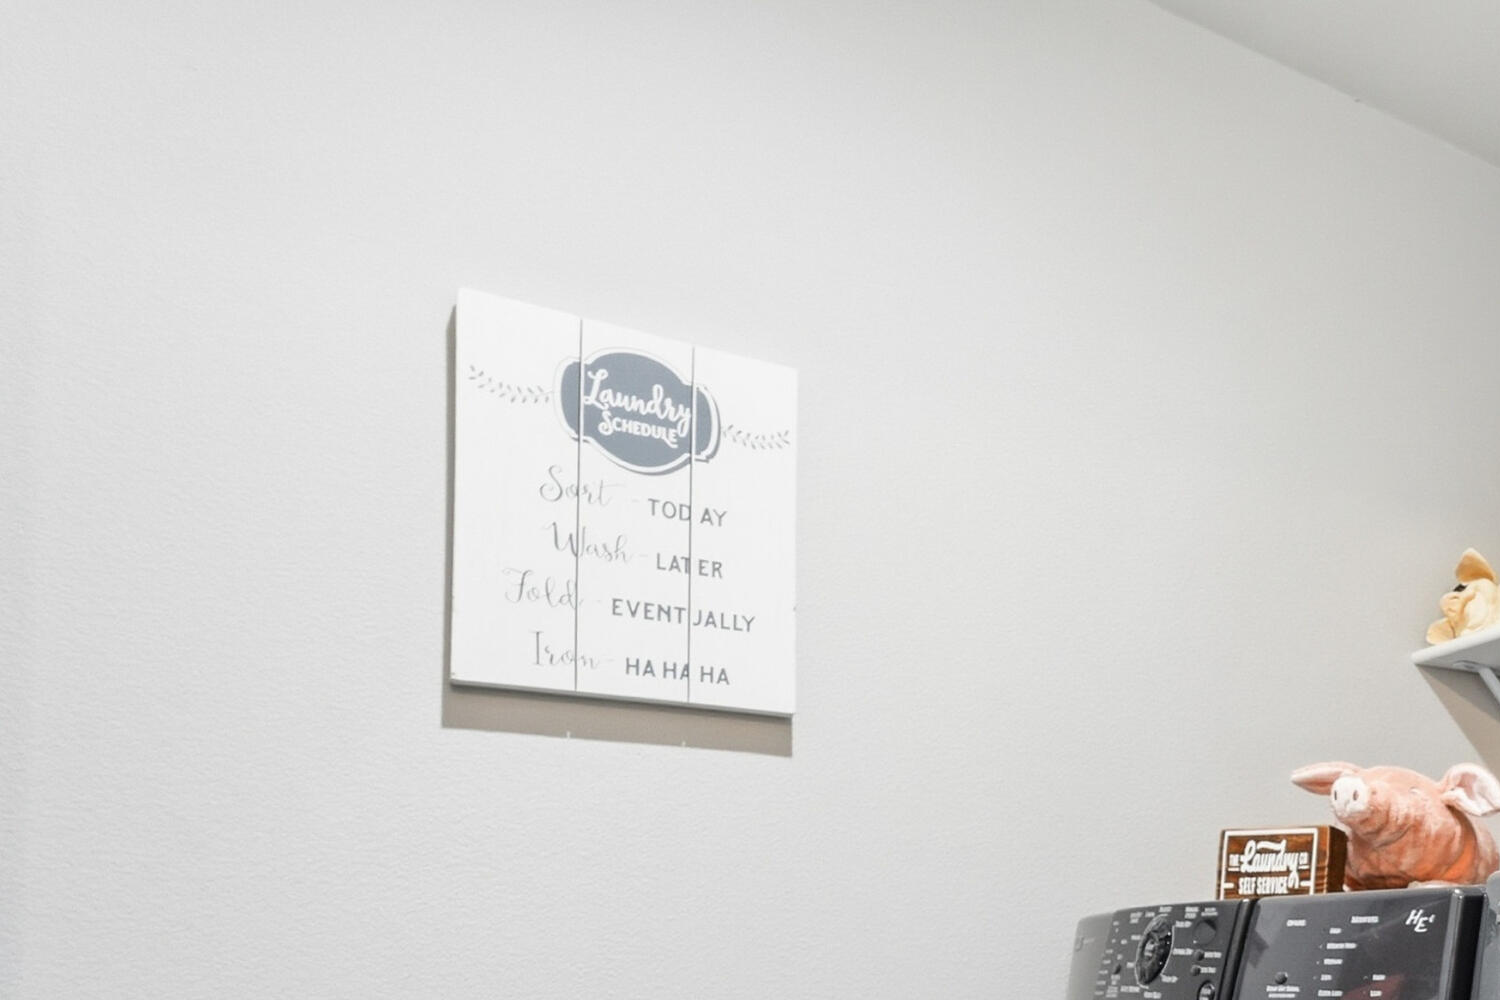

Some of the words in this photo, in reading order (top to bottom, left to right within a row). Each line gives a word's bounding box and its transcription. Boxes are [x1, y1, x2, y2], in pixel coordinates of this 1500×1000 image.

[583, 368, 691, 437] Laundry
[539, 465, 622, 506] Sort
[648, 498, 728, 527] TODAY
[542, 522, 632, 564] Wash
[656, 553, 723, 578] LATER
[502, 568, 584, 608] Fold
[530, 630, 600, 670] Iron
[625, 657, 656, 677] HA
[663, 661, 689, 681] HA
[699, 666, 730, 686] HA
[1238, 877, 1256, 895] SELF
[1240, 839, 1299, 889] Laundry
